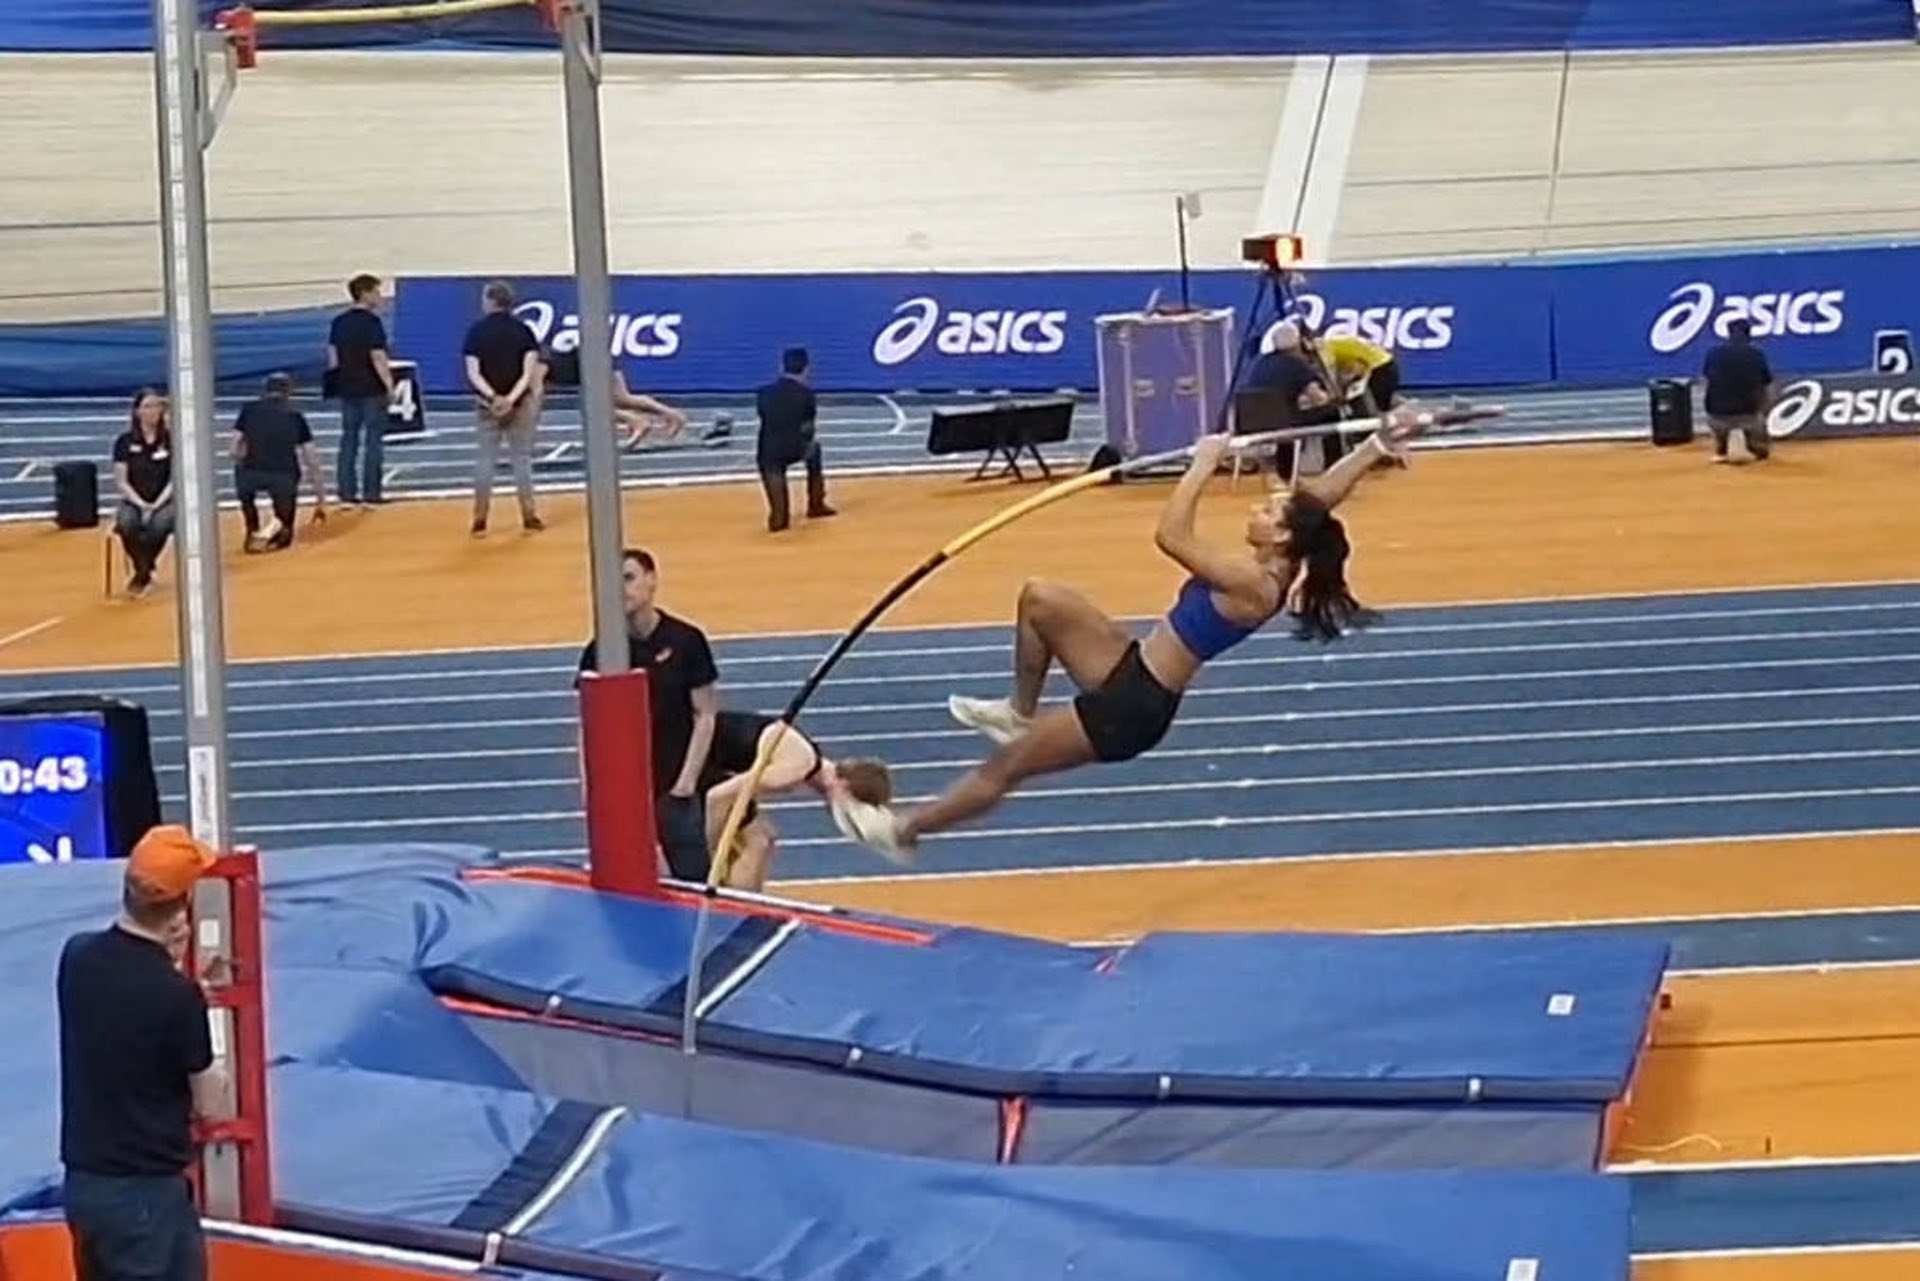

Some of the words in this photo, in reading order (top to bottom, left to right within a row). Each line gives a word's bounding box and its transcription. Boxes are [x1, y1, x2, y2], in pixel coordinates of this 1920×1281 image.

[552, 314, 683, 356] aics
[936, 311, 1067, 353] asics
[1323, 305, 1455, 349] asics
[1713, 290, 1845, 338] asics
[387, 378, 417, 421] 4
[1822, 385, 1920, 425] asic
